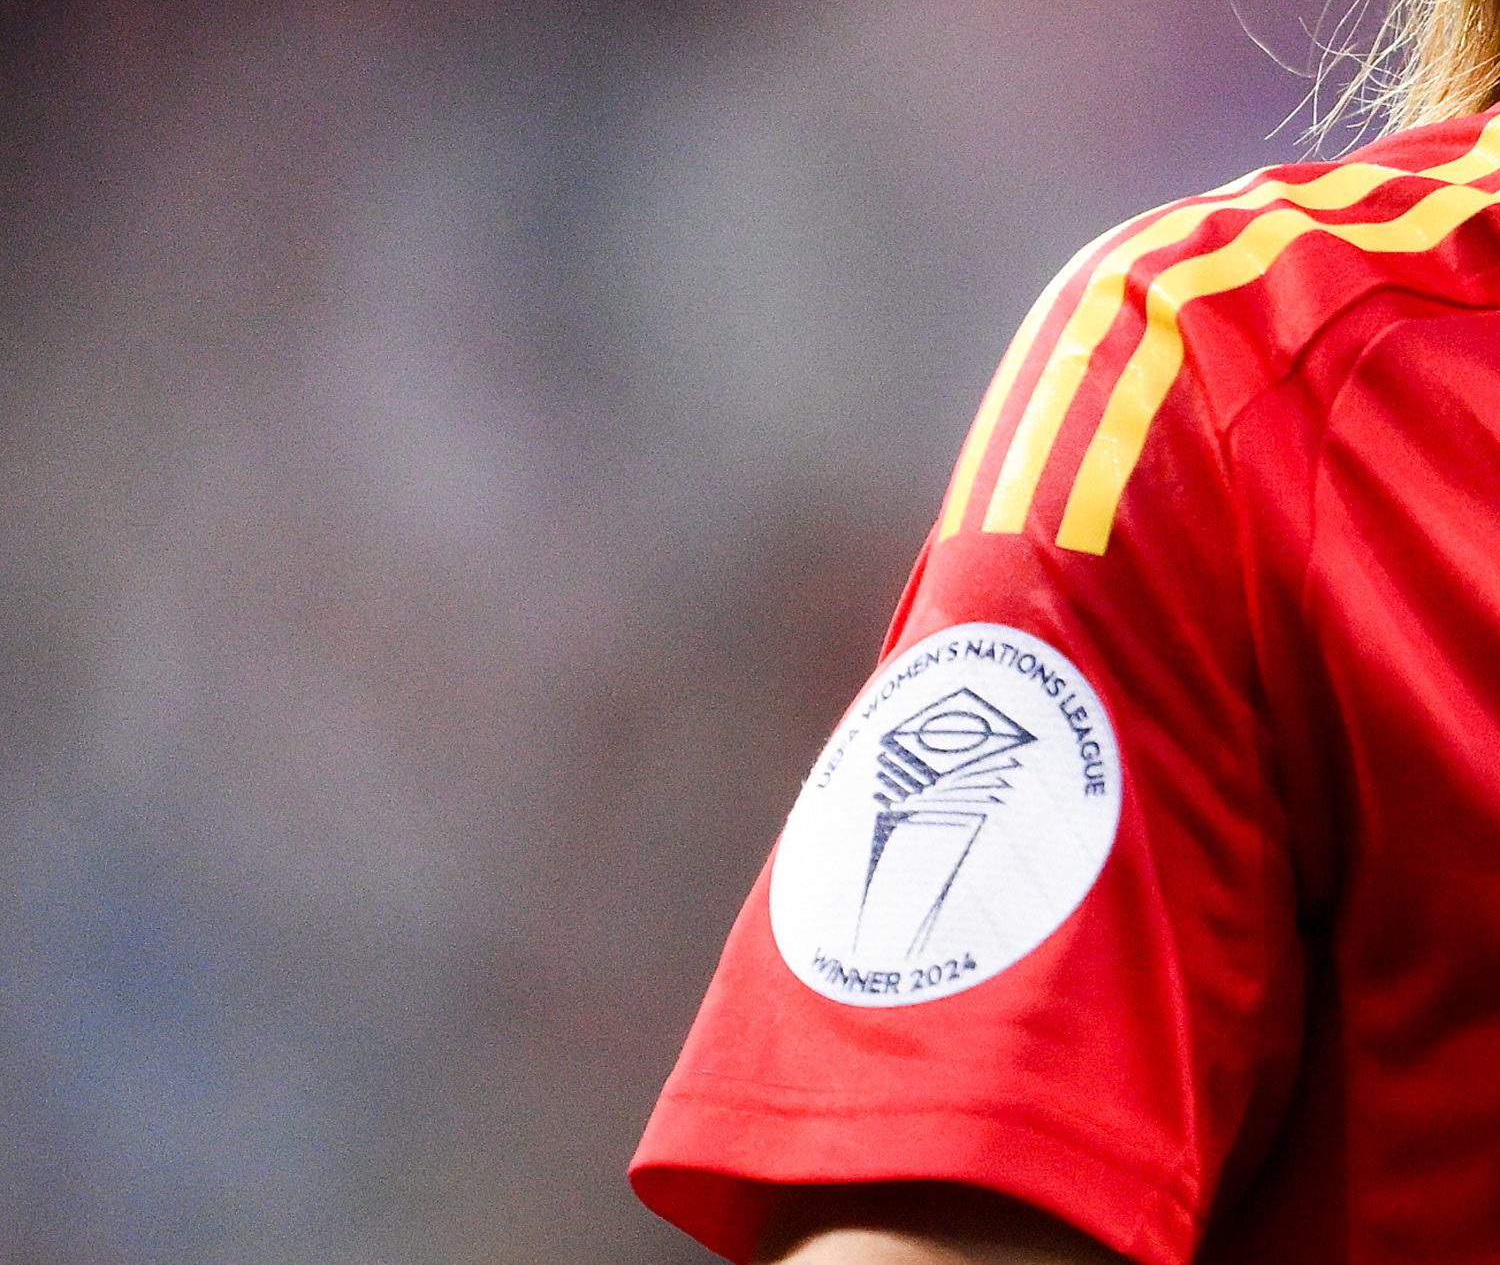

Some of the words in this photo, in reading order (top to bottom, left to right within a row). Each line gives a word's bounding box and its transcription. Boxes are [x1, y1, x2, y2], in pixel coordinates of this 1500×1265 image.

[965, 639, 1066, 697] NATIONS
[1059, 693, 1106, 797] LEAGUE
[812, 946, 901, 995] WINNER
[909, 951, 977, 992] 2024
